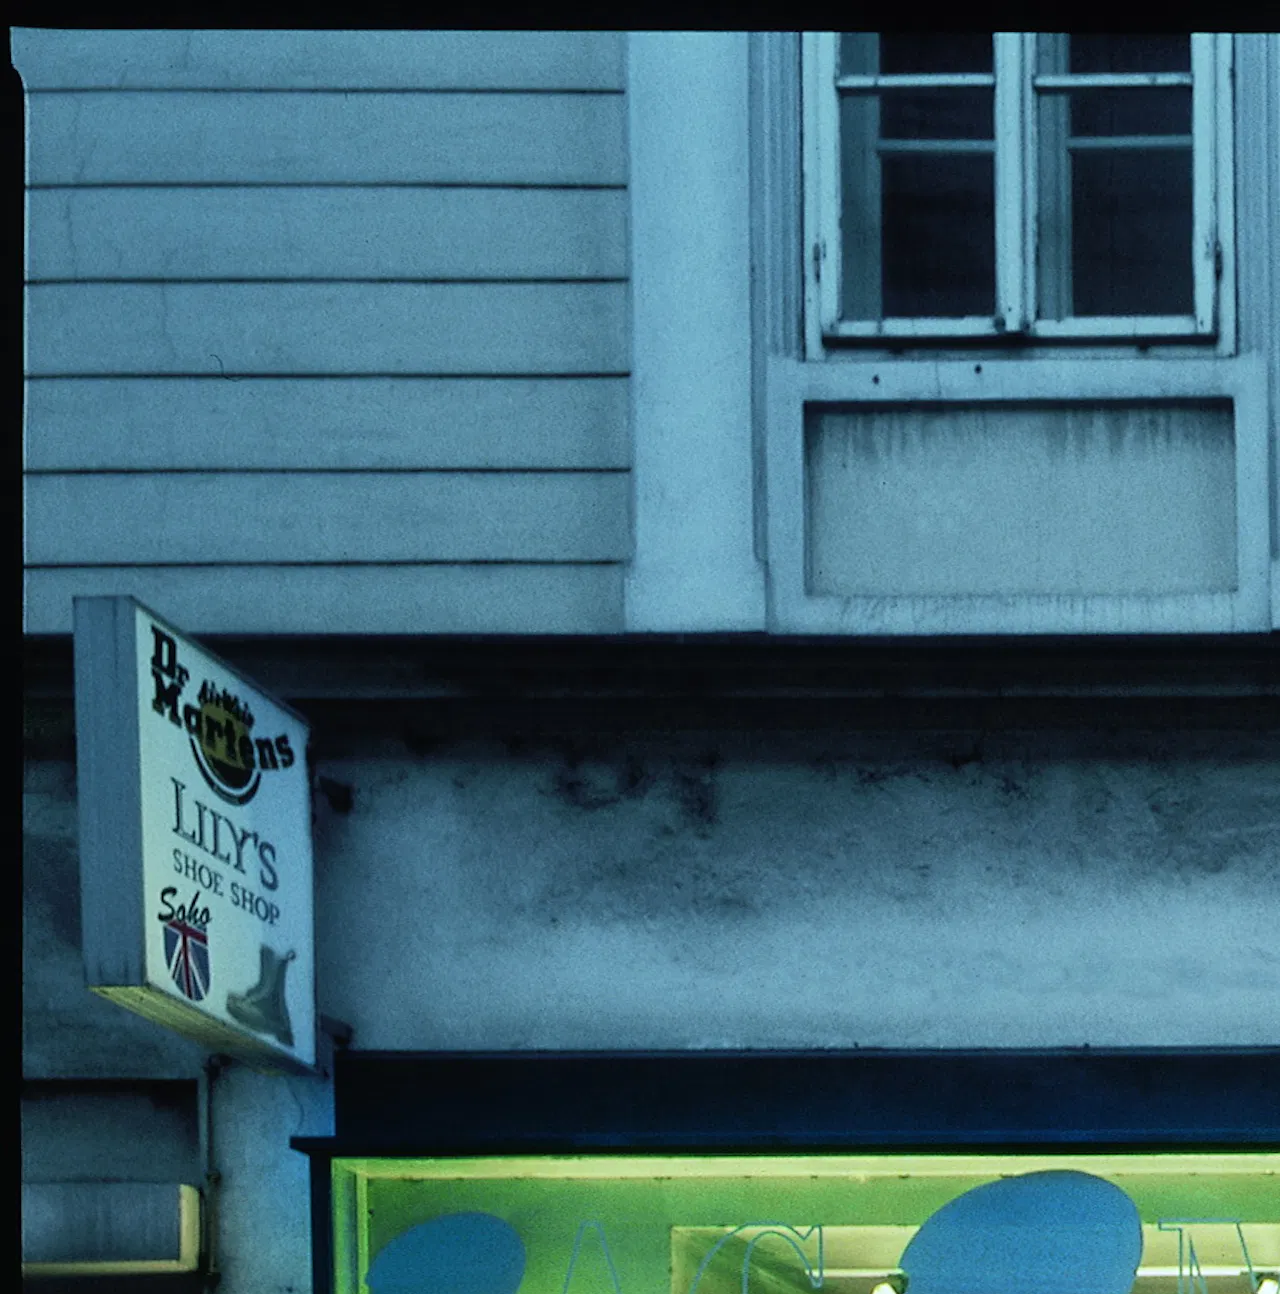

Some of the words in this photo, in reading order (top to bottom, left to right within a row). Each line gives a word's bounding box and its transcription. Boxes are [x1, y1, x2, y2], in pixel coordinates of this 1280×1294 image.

[151, 625, 190, 688] Dr
[151, 668, 296, 771] Martens
[170, 776, 280, 892] LILY'S
[157, 886, 212, 926] Soho
[172, 848, 224, 898] SHOE
[229, 881, 281, 926] SHOP
